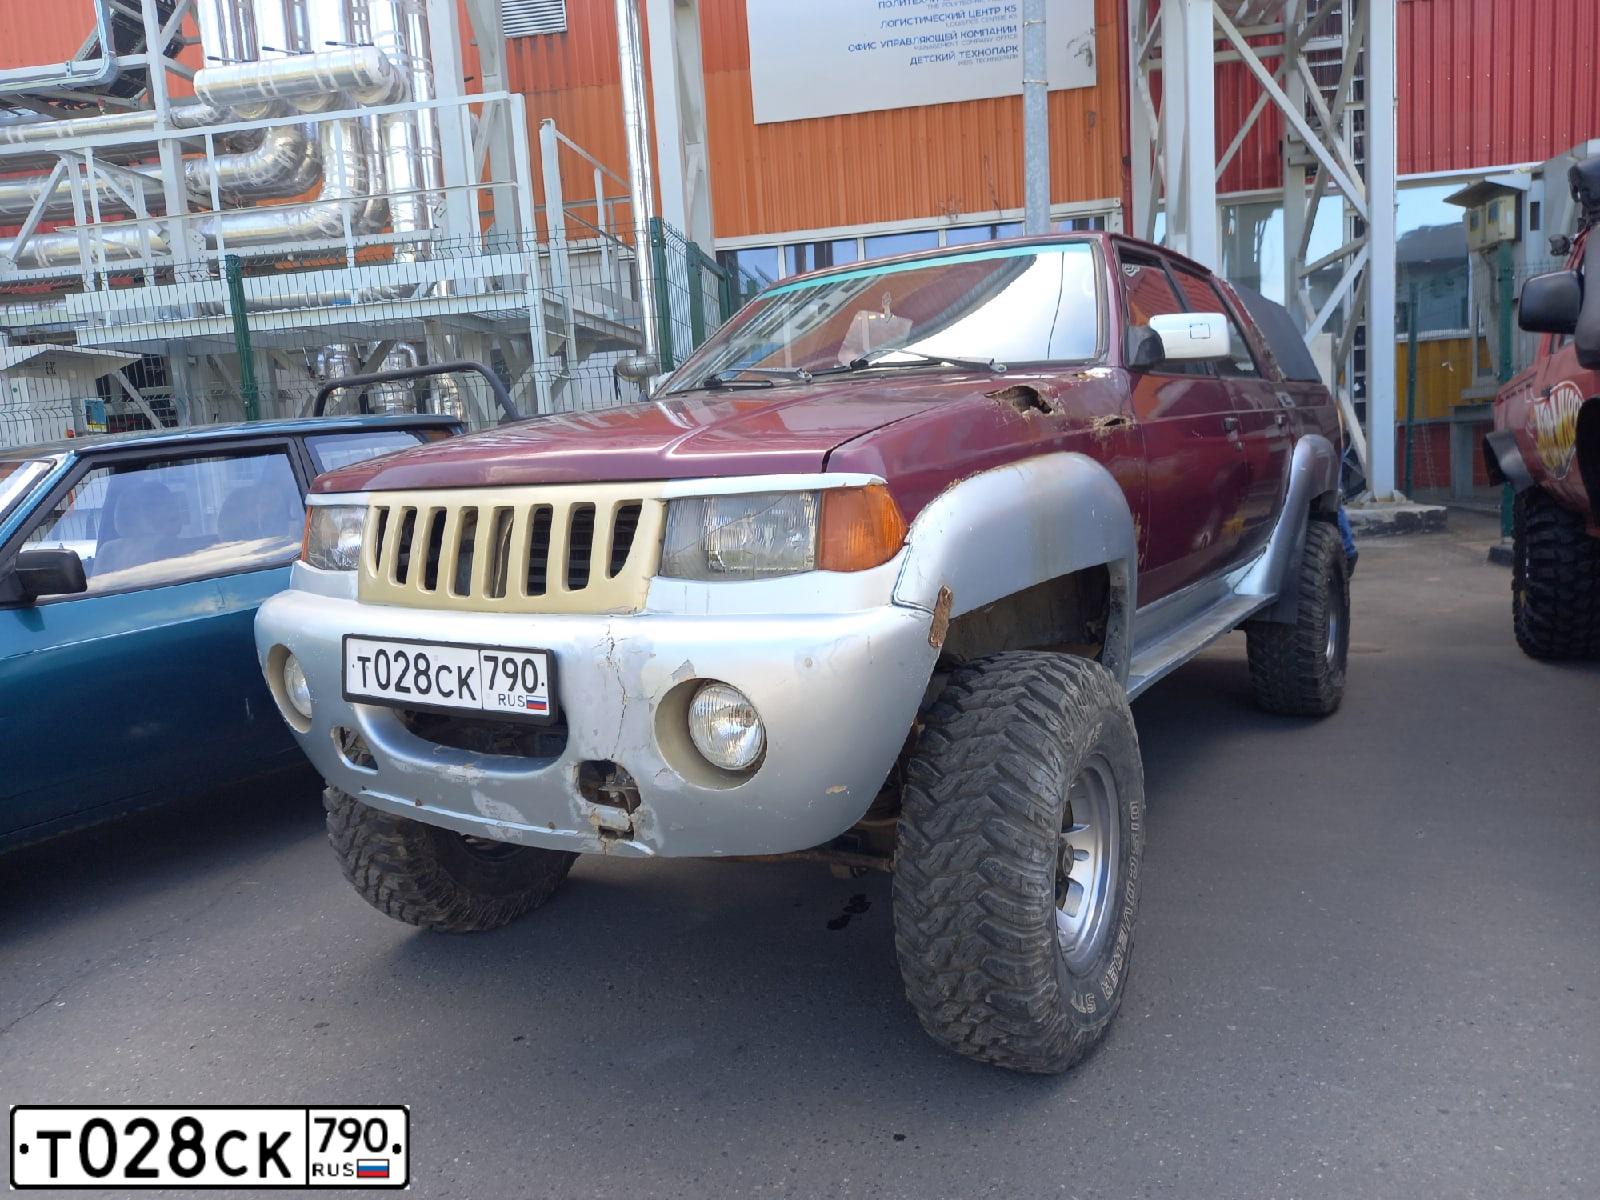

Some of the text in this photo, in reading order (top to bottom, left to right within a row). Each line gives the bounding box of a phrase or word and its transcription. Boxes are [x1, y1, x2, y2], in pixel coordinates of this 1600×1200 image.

[880, 10, 966, 29] ЛОГИСТИЧЕСКИЙ
[968, 6, 1001, 19] ЦЕНТР
[848, 25, 1018, 52] ОФИС УПРАВЛЯЮЩЕЙ КОМПАНИИ
[909, 45, 1019, 66] ДЕТСКИЙ ТЕХНОПАРК
[483, 655, 539, 694] 790
[498, 693, 526, 708] RUS
